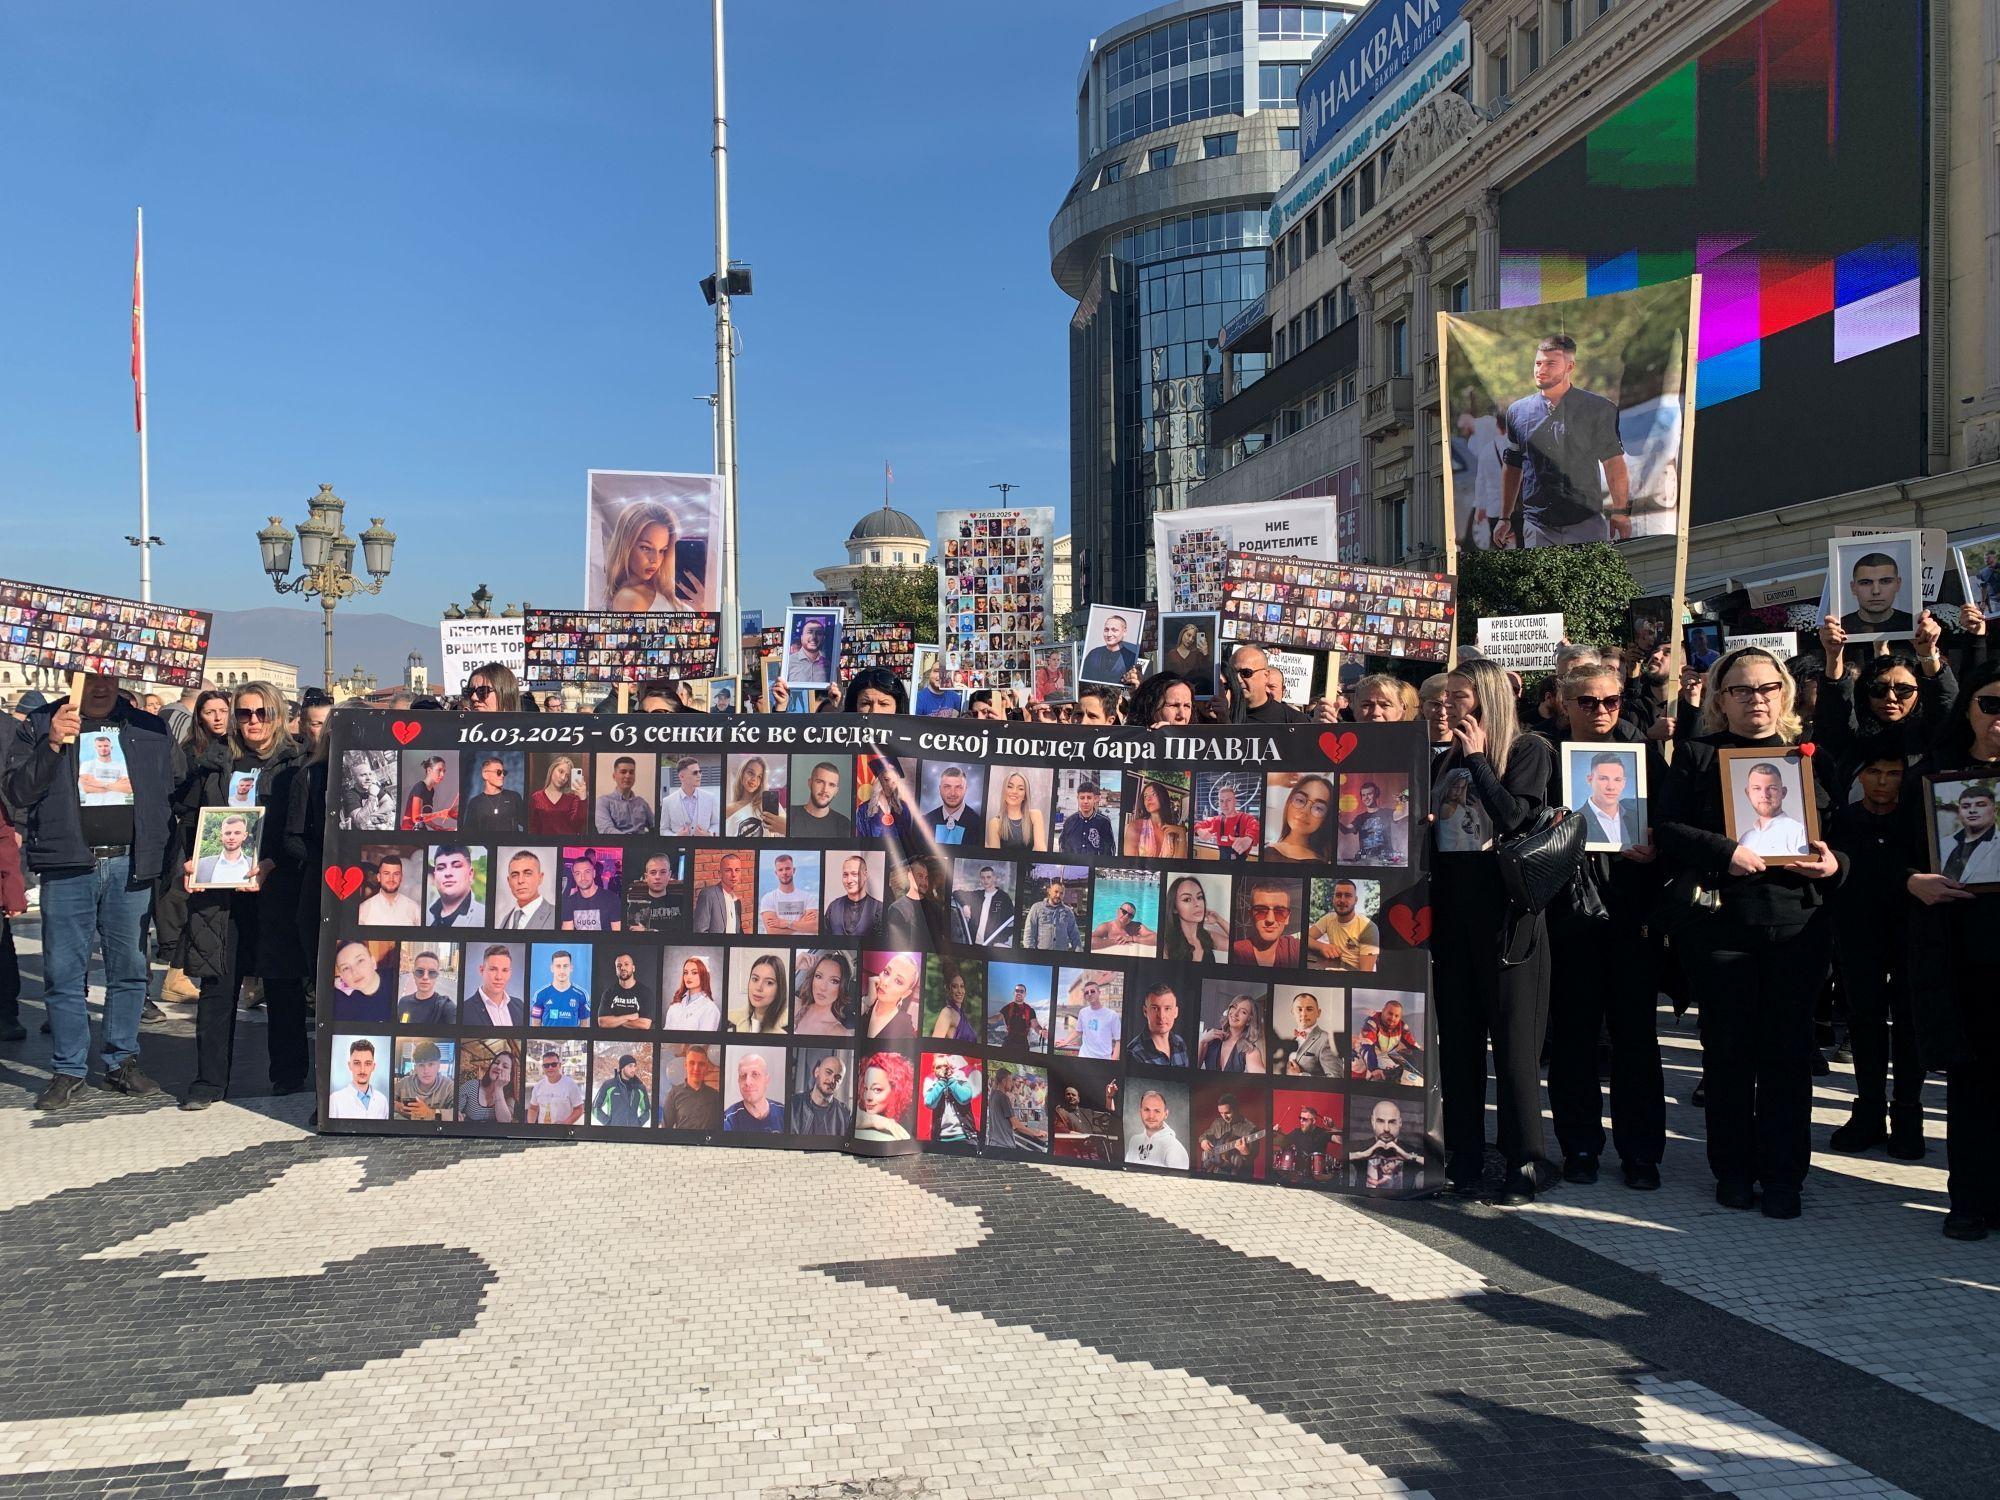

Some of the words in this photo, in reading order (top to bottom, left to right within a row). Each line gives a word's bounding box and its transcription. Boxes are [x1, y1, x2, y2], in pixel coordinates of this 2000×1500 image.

[1374, 57, 1399, 92] ВАЖНИ
[1401, 45, 1410, 65] СЕ
[1283, 167, 1328, 223] TURKISH
[1329, 125, 1374, 181] MAARIF
[1374, 37, 1466, 139] FOUNDATION
[1265, 521, 1290, 532] НИЕ
[1238, 535, 1318, 553] РОДИТЕЛИТЕ
[1491, 619, 1508, 629] КРИВ
[1509, 619, 1513, 628] Е
[1513, 617, 1548, 628] СИСТЕМОТ,
[1491, 632, 1499, 641] НЕ
[1500, 631, 1518, 641] БЕШЕ
[1519, 628, 1549, 640] НЕСРЕЌА.
[445, 642, 498, 655] ВРШИТЕ
[501, 642, 525, 653] ТОР
[1483, 644, 1502, 655] БЕШЕ
[1506, 657, 1515, 667] ЗА
[1515, 656, 1542, 667] НАШИТЕ
[1542, 655, 1556, 667] ДЕЦ
[457, 722, 585, 746] 16.03.2025
[610, 722, 638, 747] 63
[644, 726, 724, 743] сенки
[729, 720, 760, 743] ќе
[767, 726, 796, 743] ве
[803, 726, 893, 748] следат
[919, 729, 989, 759] секој
[995, 736, 1086, 762] поглед
[1092, 735, 1157, 764] бара
[1163, 736, 1283, 766] ПРАВДА
